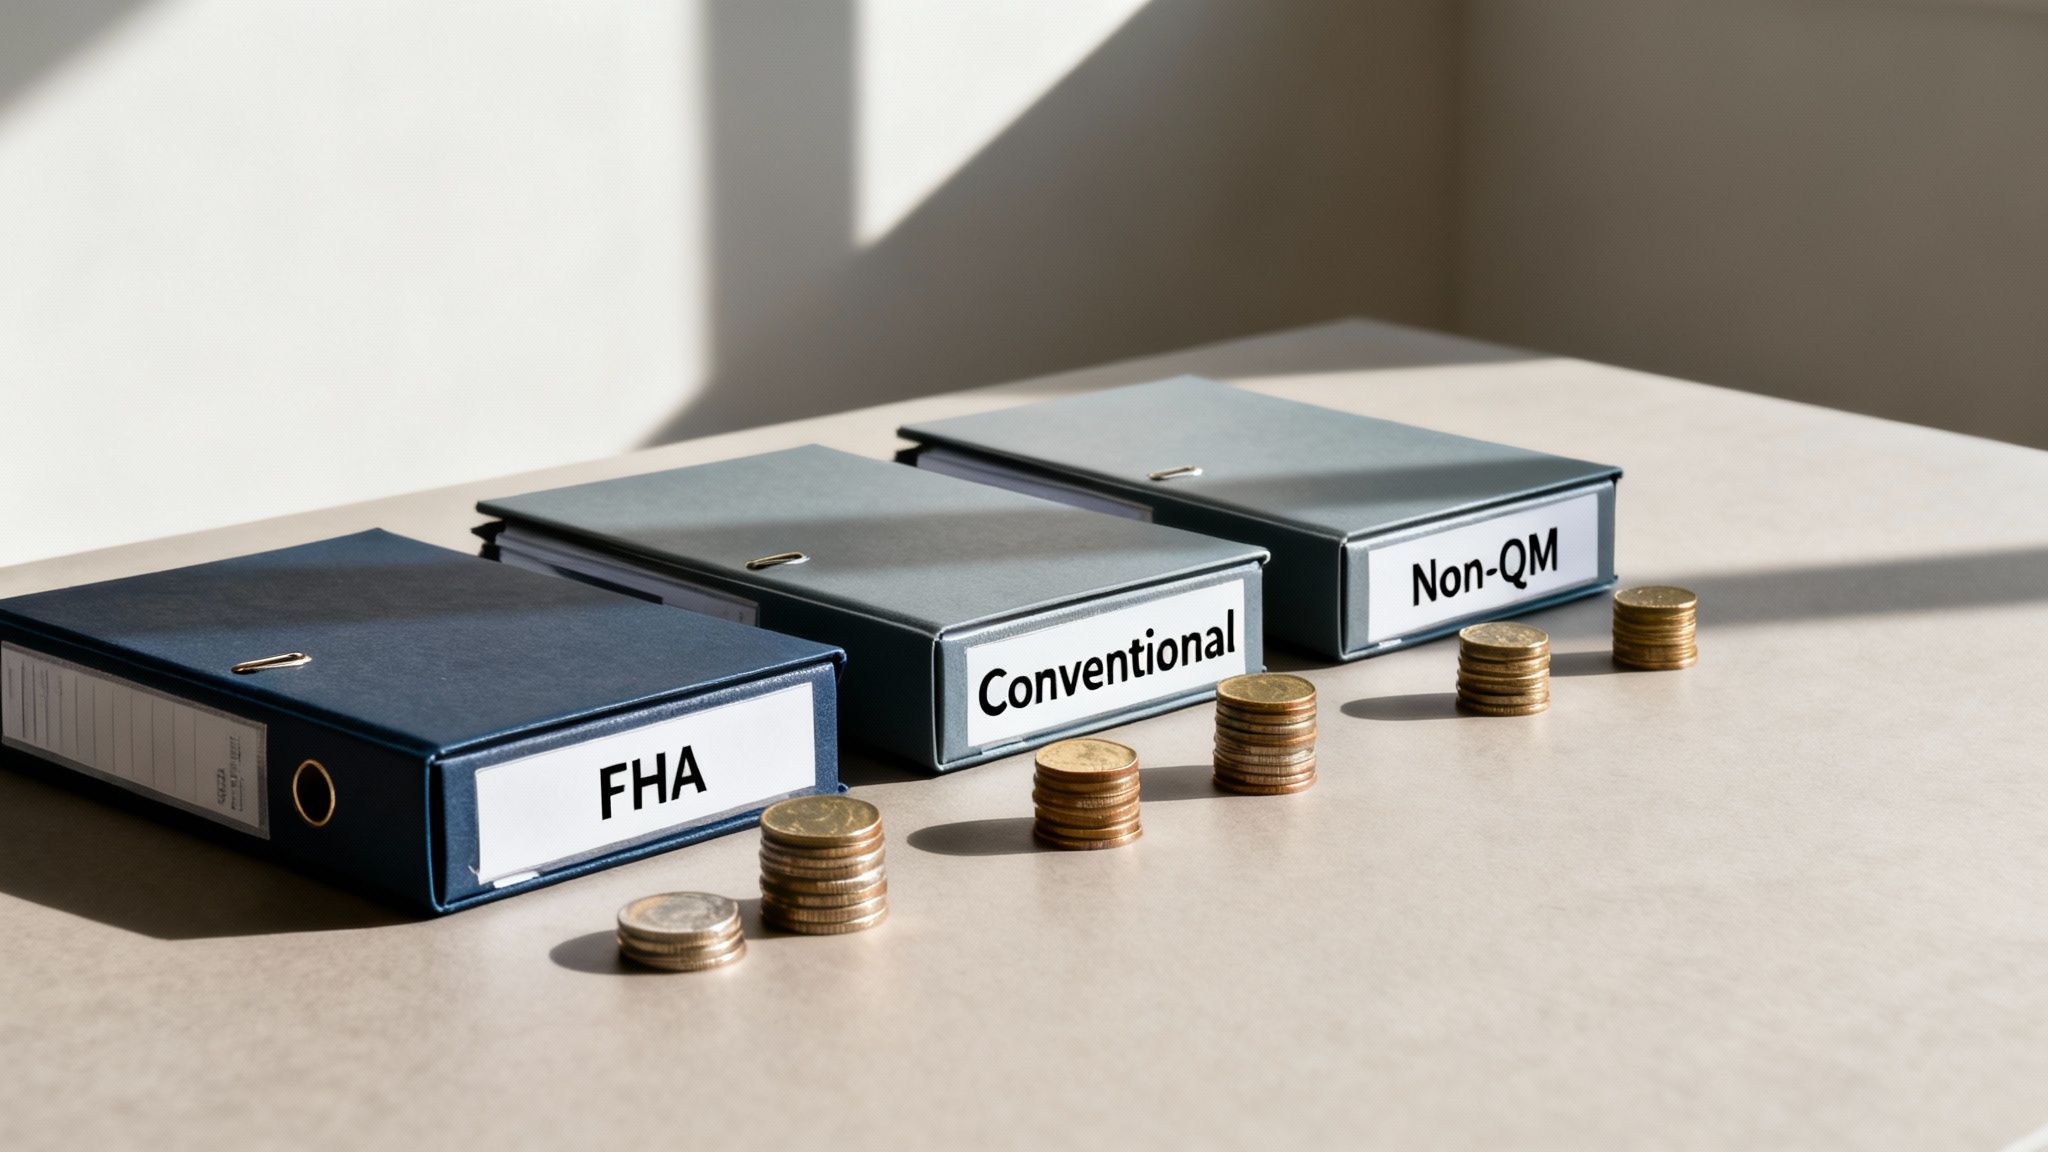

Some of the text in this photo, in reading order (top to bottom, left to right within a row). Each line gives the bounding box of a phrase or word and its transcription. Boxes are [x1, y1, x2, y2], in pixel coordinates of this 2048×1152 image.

[1412, 527, 1558, 607] Non-QM
[978, 608, 1235, 717] Conventional
[599, 745, 707, 821] FHA
